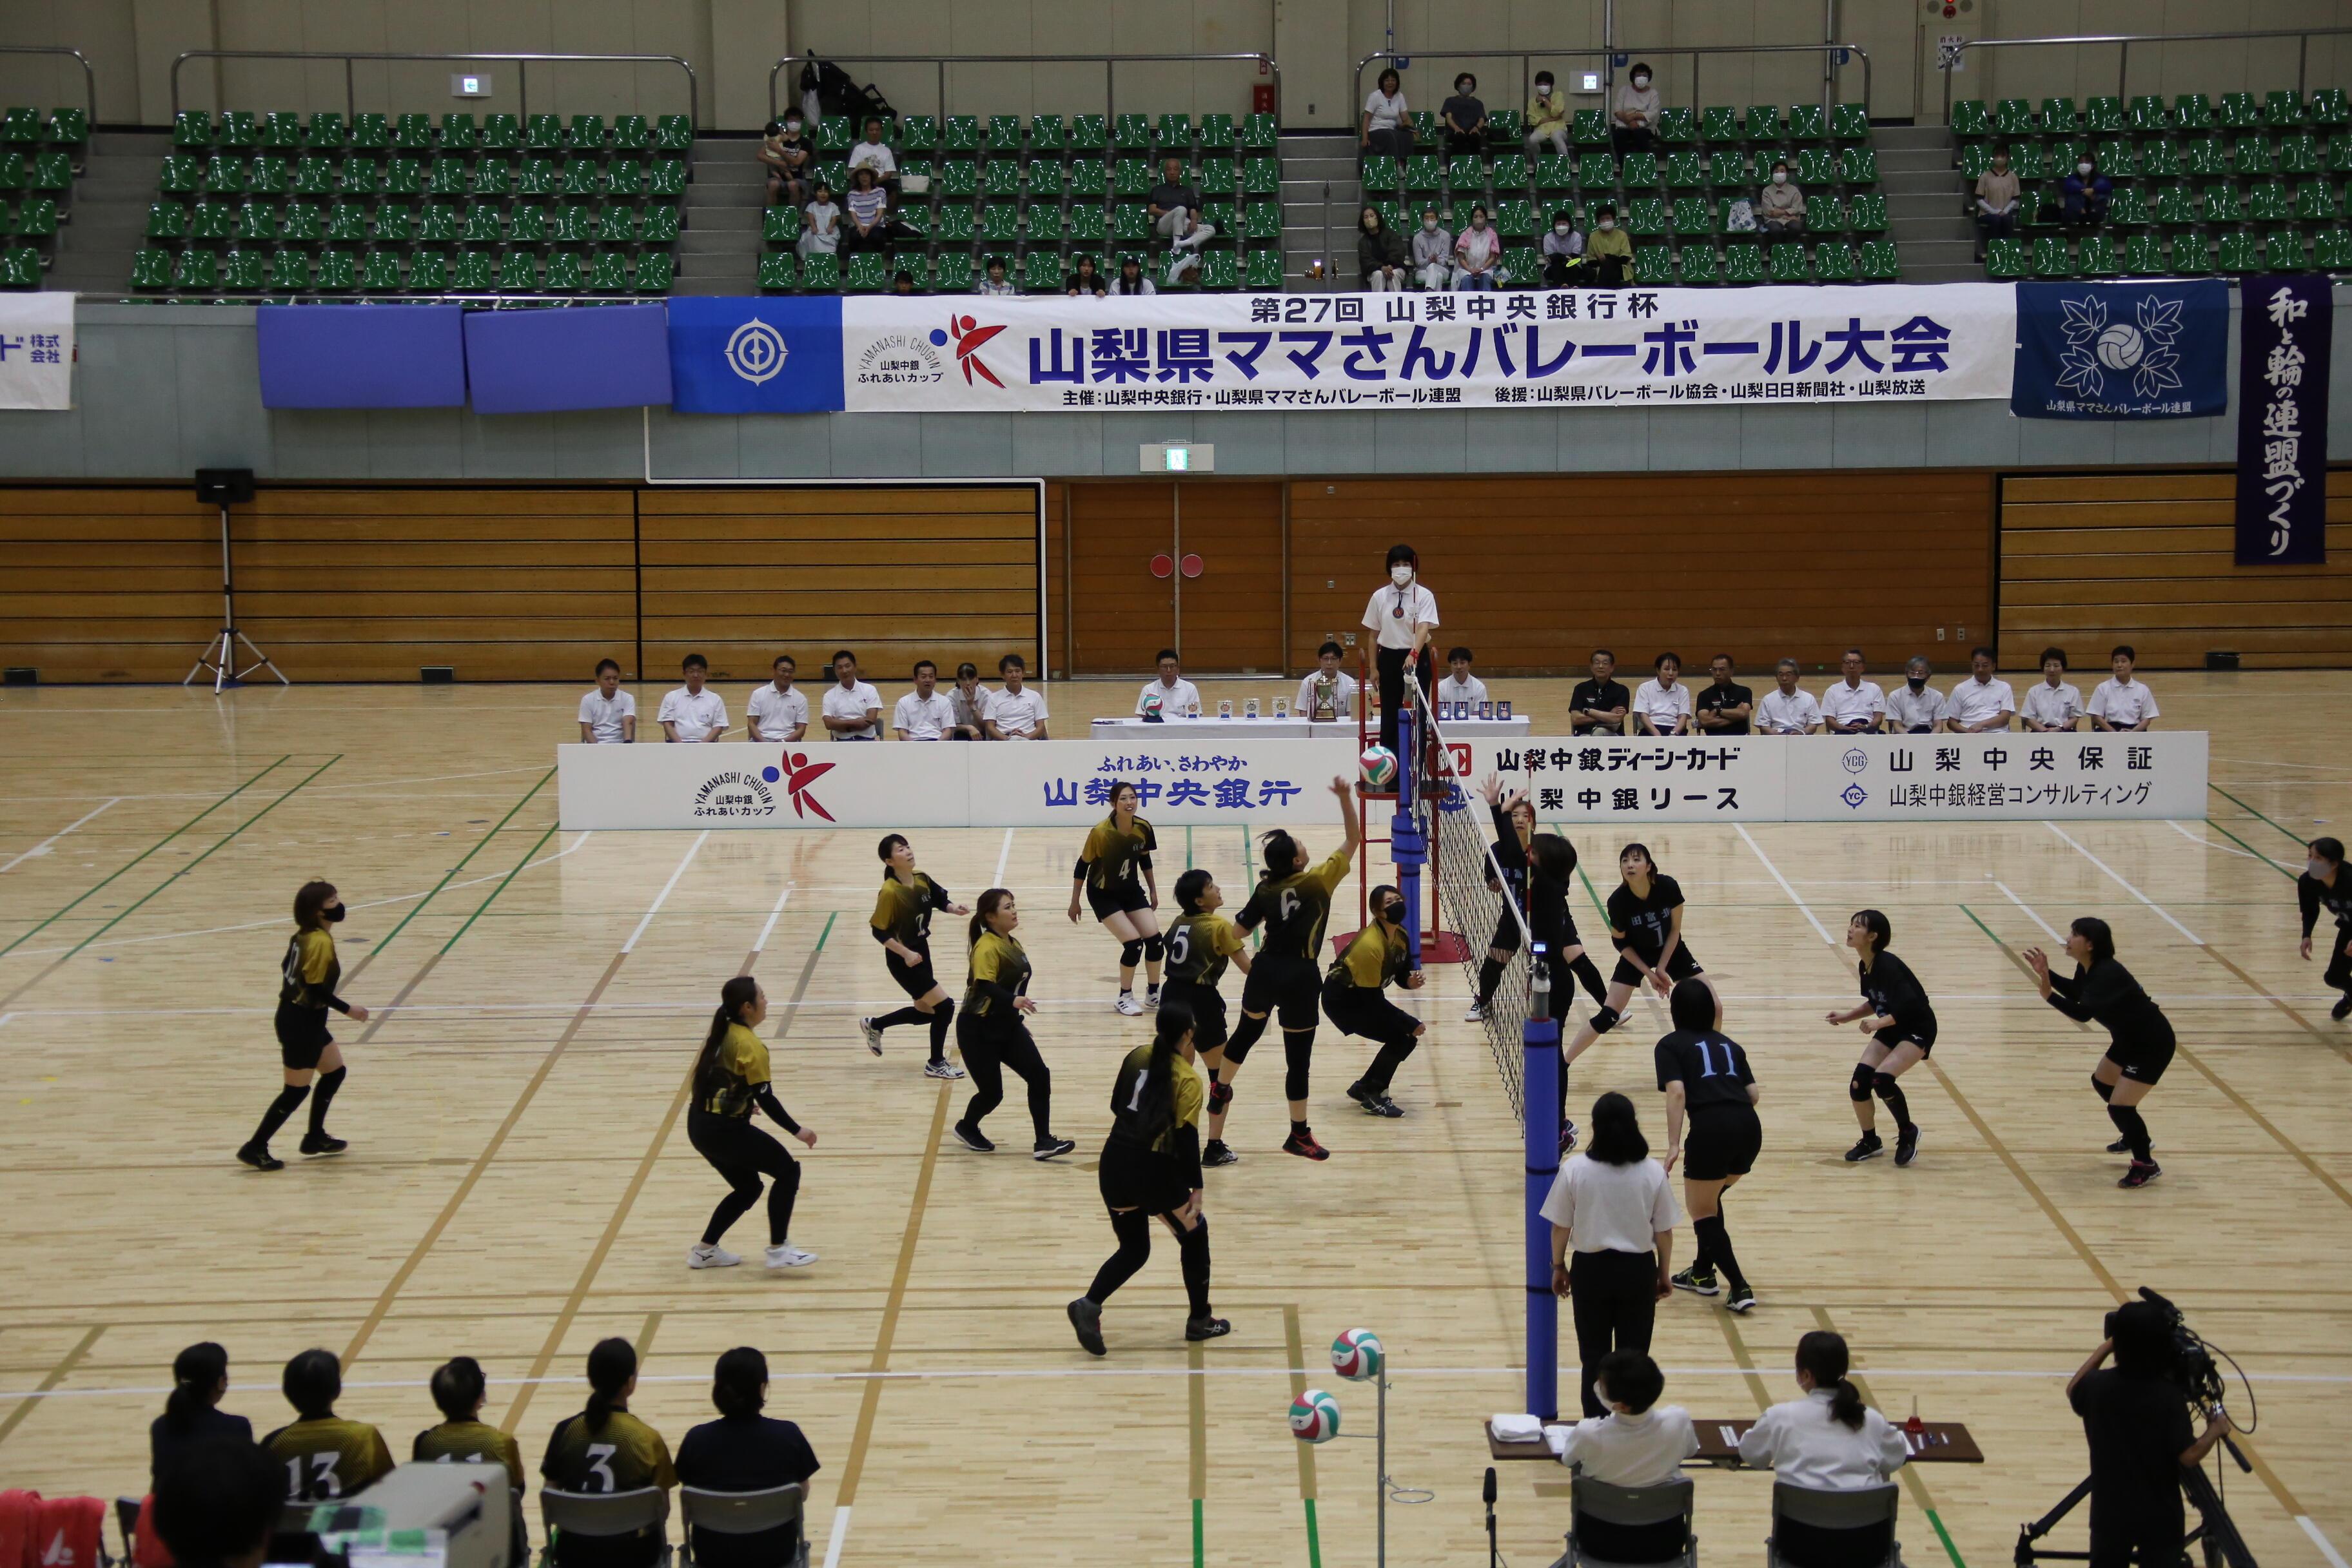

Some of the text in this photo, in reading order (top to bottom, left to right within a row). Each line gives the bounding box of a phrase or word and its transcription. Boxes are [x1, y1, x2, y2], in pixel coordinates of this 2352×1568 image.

[1251, 293, 1659, 324] 第27回 山梨中央銀行杯
[30, 334, 59, 348] 株式
[858, 335, 941, 370] YAMANASHI CHUGIN
[1029, 315, 1952, 385] 山梨県ママさんバレーボール大会
[30, 349, 60, 364] 会社
[880, 360, 919, 371] 山梨中銀
[858, 372, 944, 384] ふれあいカップ
[2046, 400, 2192, 415] 山梨県ママさんバレーボール連盟
[2262, 287, 2308, 556] 和と輪の連盟づくり
[1097, 754, 1248, 772] ふれあい、さわやか
[1496, 747, 1741, 773] 山梨中銀ディーシーカード
[1846, 756, 1864, 767] YCG
[1890, 746, 2152, 772] 山梨中央保証
[694, 772, 774, 805] YAMANASHI CHUGIN
[716, 795, 754, 805] 山梨中銀
[1890, 781, 2152, 807] 山梨中銀経営コンサルティング
[694, 805, 776, 816] ふれあいカップ
[1119, 858, 1131, 880] 4
[1280, 888, 1301, 921] 6
[1170, 925, 1191, 965] 5
[1694, 1040, 1739, 1079] 11
[284, 1451, 342, 1498] 13
[582, 1443, 617, 1493] 3
